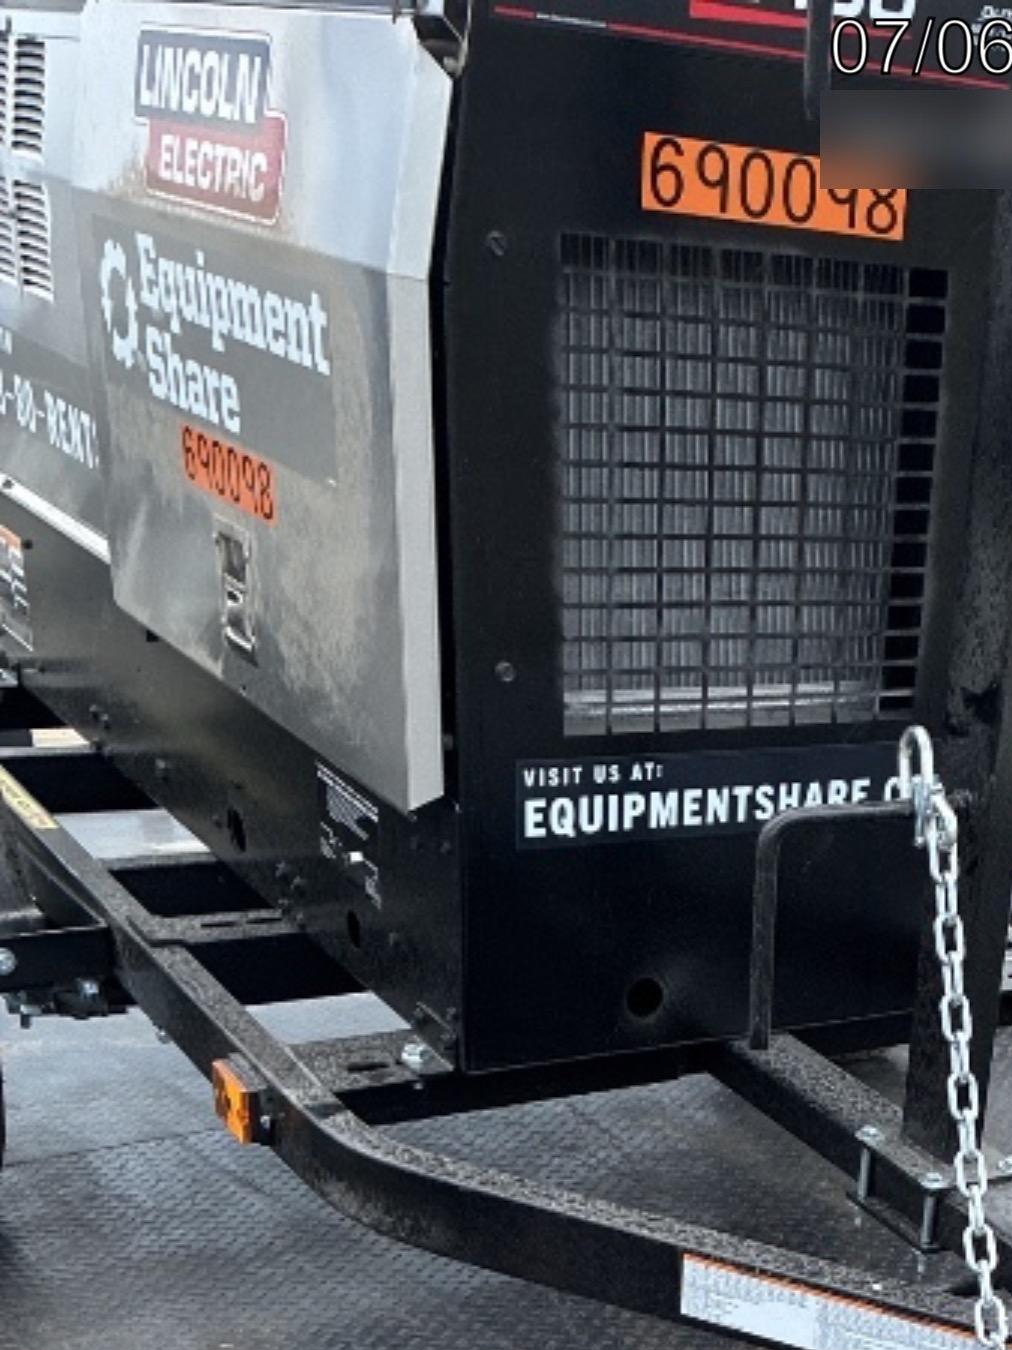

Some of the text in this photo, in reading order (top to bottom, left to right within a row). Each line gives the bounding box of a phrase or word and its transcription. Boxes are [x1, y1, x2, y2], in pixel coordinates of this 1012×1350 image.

[140, 44, 262, 124] LINCOLN
[159, 134, 268, 202] ELECTRIC
[136, 231, 331, 376] Equipment
[146, 326, 241, 434] Share
[183, 425, 274, 520] 690098
[523, 761, 664, 787] VISIT US AT:
